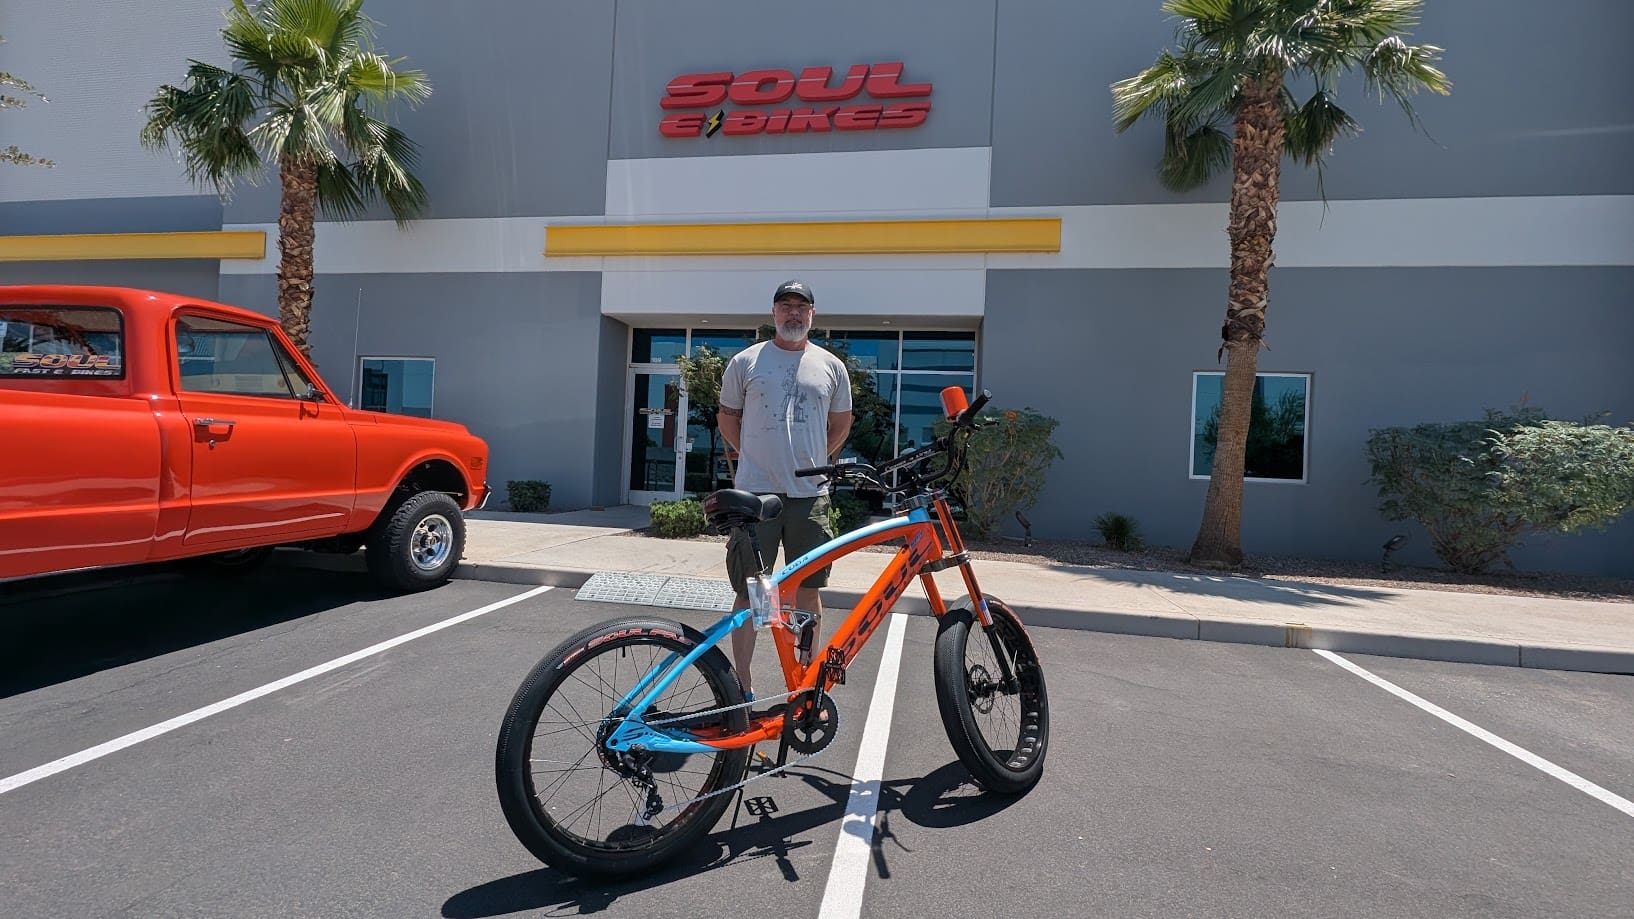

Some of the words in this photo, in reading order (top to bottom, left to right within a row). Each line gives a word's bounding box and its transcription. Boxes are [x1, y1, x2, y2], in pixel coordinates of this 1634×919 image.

[660, 62, 933, 109] SOUL
[722, 102, 932, 136] BIKES
[13, 353, 121, 368] SOUL
[840, 540, 933, 658] SOUL
